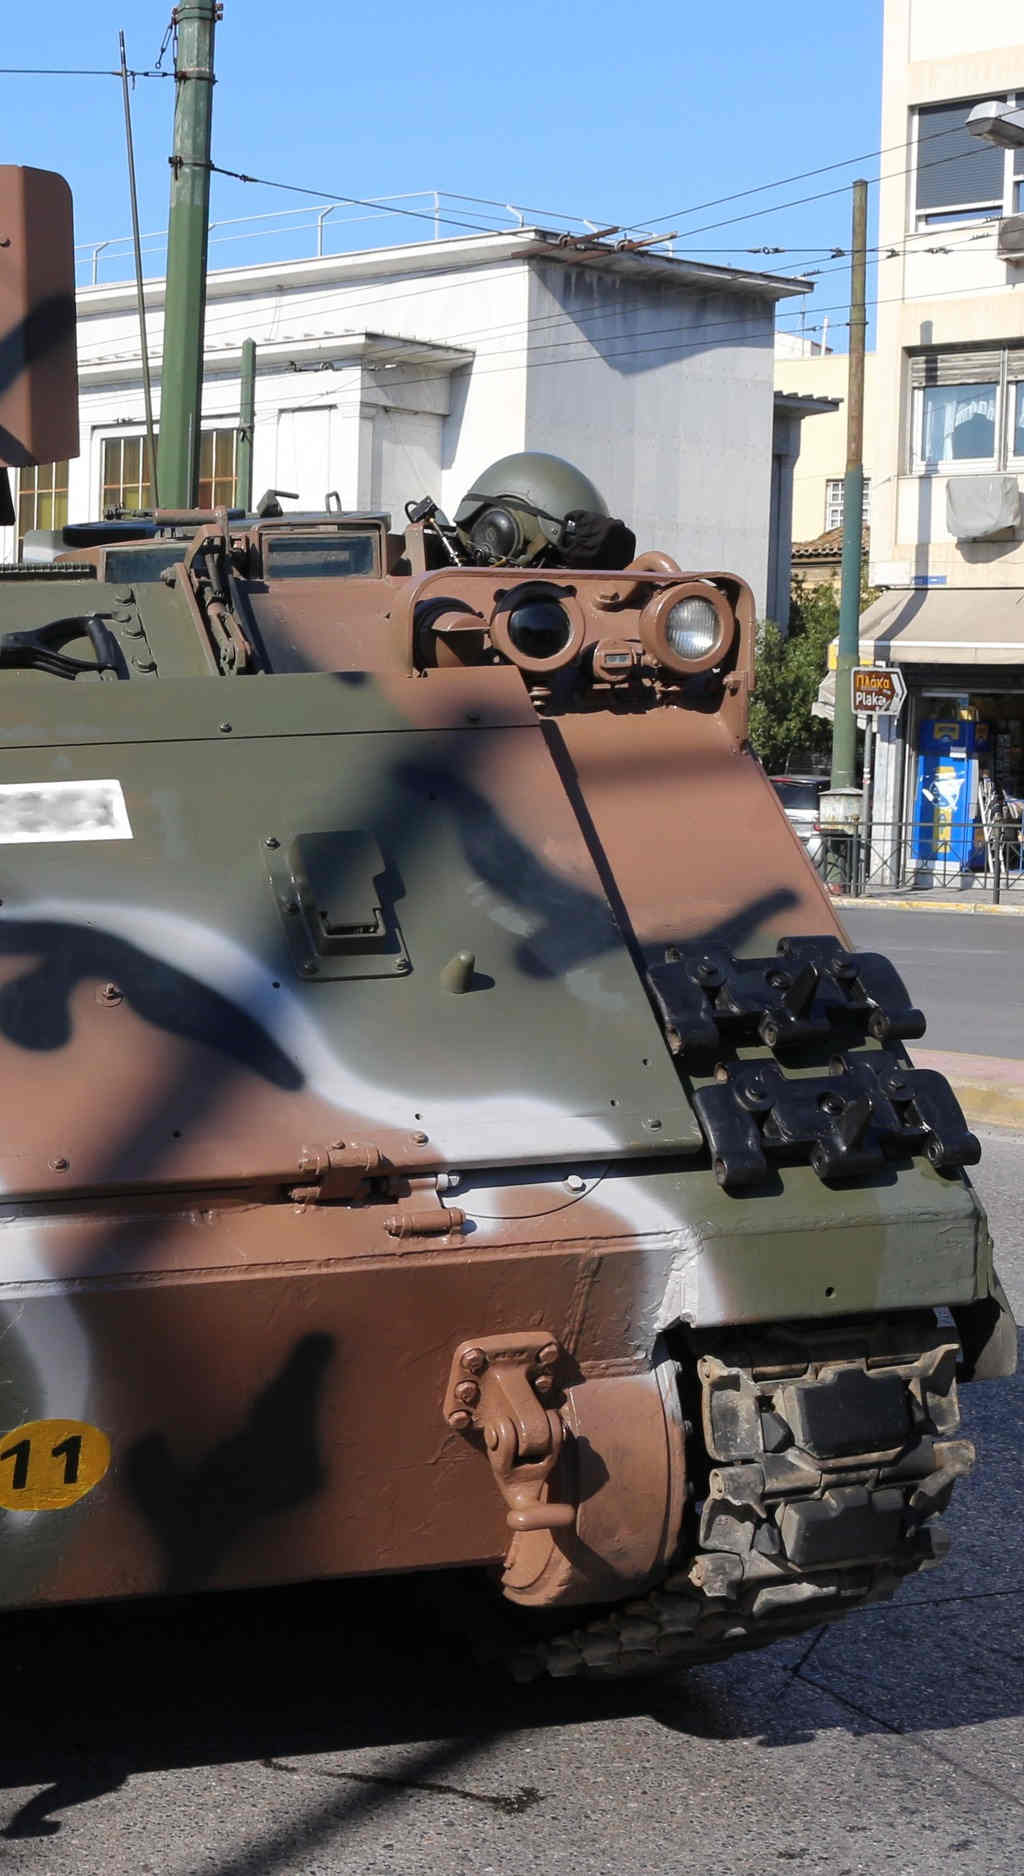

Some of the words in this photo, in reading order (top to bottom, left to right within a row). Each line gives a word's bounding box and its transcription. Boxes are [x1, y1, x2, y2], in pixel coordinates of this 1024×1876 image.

[856, 674, 890, 689] Πλάκα
[856, 691, 887, 706] Plaka
[0, 1435, 82, 1489] 11
